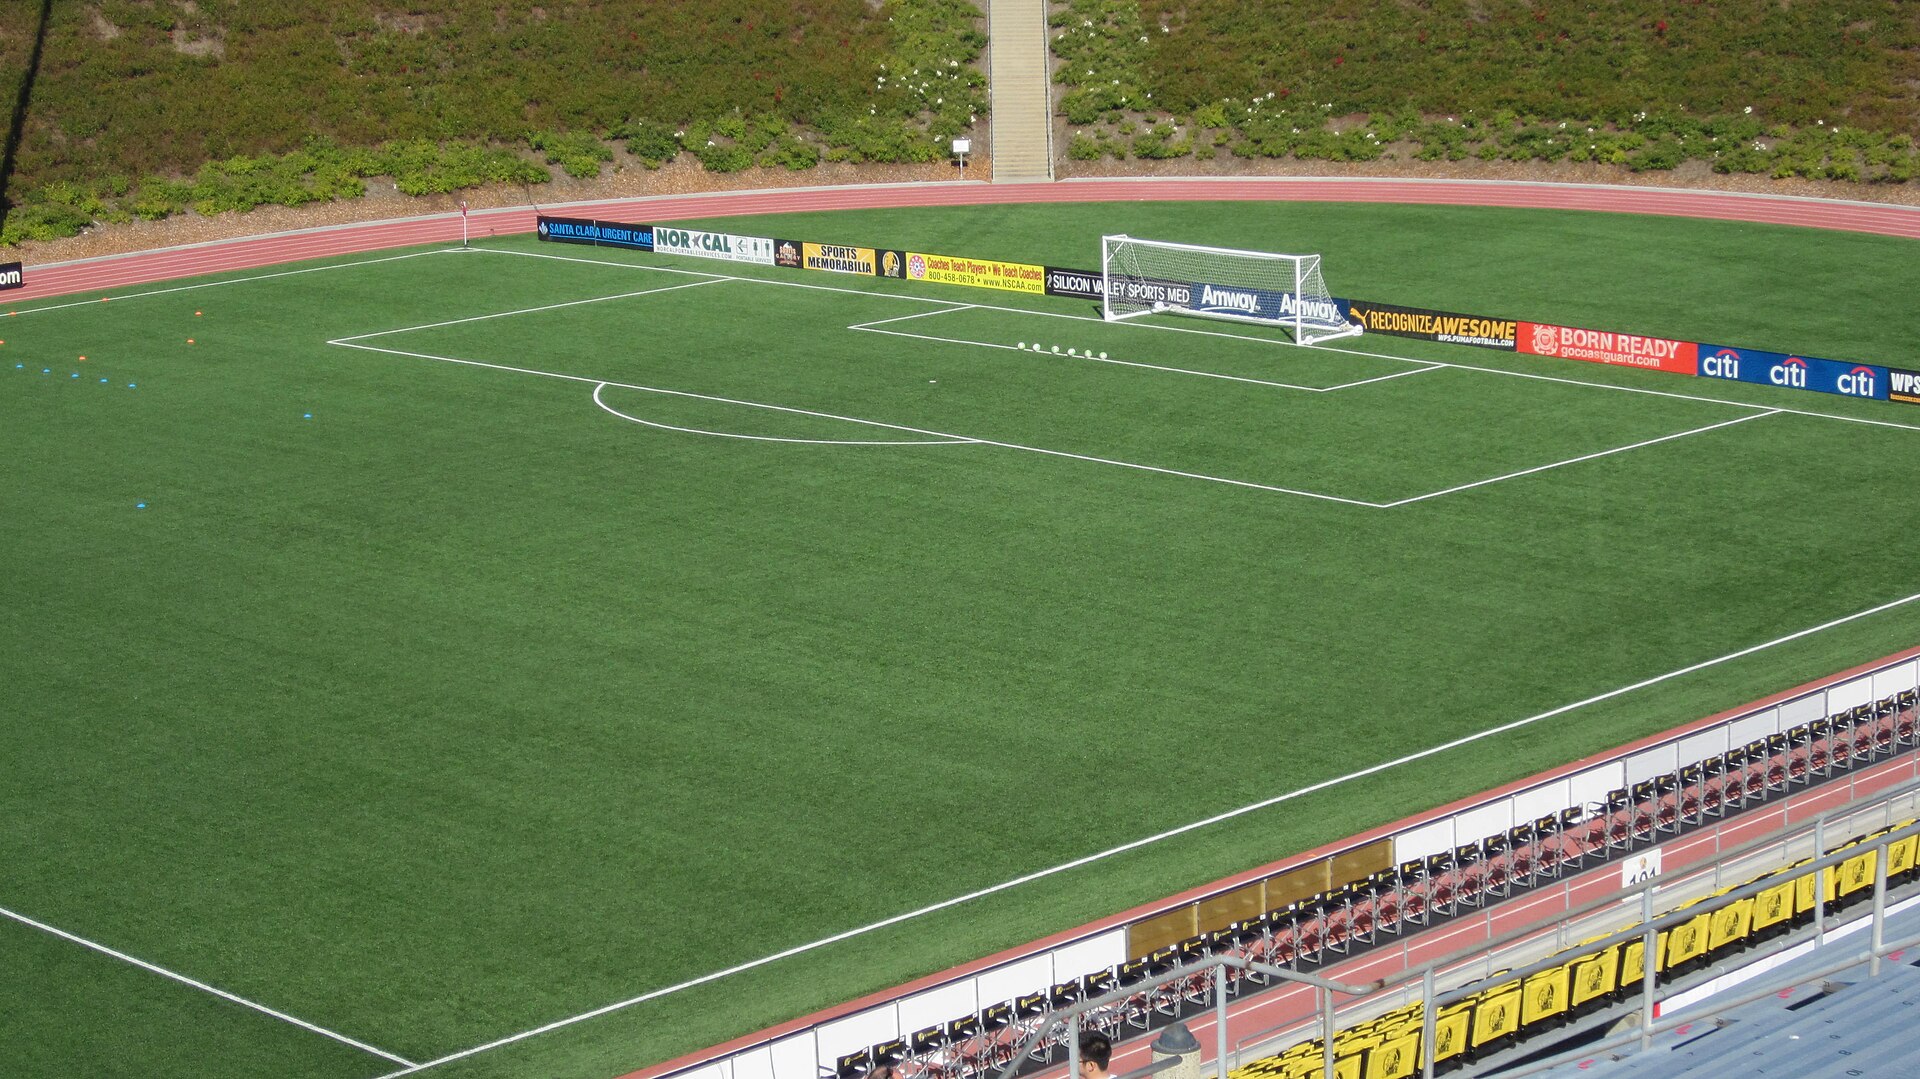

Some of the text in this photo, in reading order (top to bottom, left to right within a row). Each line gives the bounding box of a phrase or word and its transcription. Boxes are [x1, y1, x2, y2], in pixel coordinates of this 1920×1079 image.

[549, 223, 653, 244] SANTA CLARA URGENT CARE
[656, 228, 732, 253] NOR CAL
[807, 256, 872, 274] MEMORABILIA
[820, 245, 857, 260] SPORTS
[927, 257, 1042, 280] Coaches Teach Players We Teach Coaches
[928, 271, 1042, 291] 800-458-0678 www.NSCAA.com
[1053, 274, 1190, 303] SILICON VALEY SPORTS MED
[1201, 284, 1258, 313] Amway
[1280, 293, 1338, 322] Amway
[1437, 334, 1514, 347] WPS.PUMAFOOTBALL.COM
[1560, 327, 1679, 359] BORN READY
[1561, 346, 1660, 367] gocoastguard.com
[1703, 353, 1739, 379] citi
[1770, 362, 1806, 388] citi
[1837, 371, 1874, 397] citi
